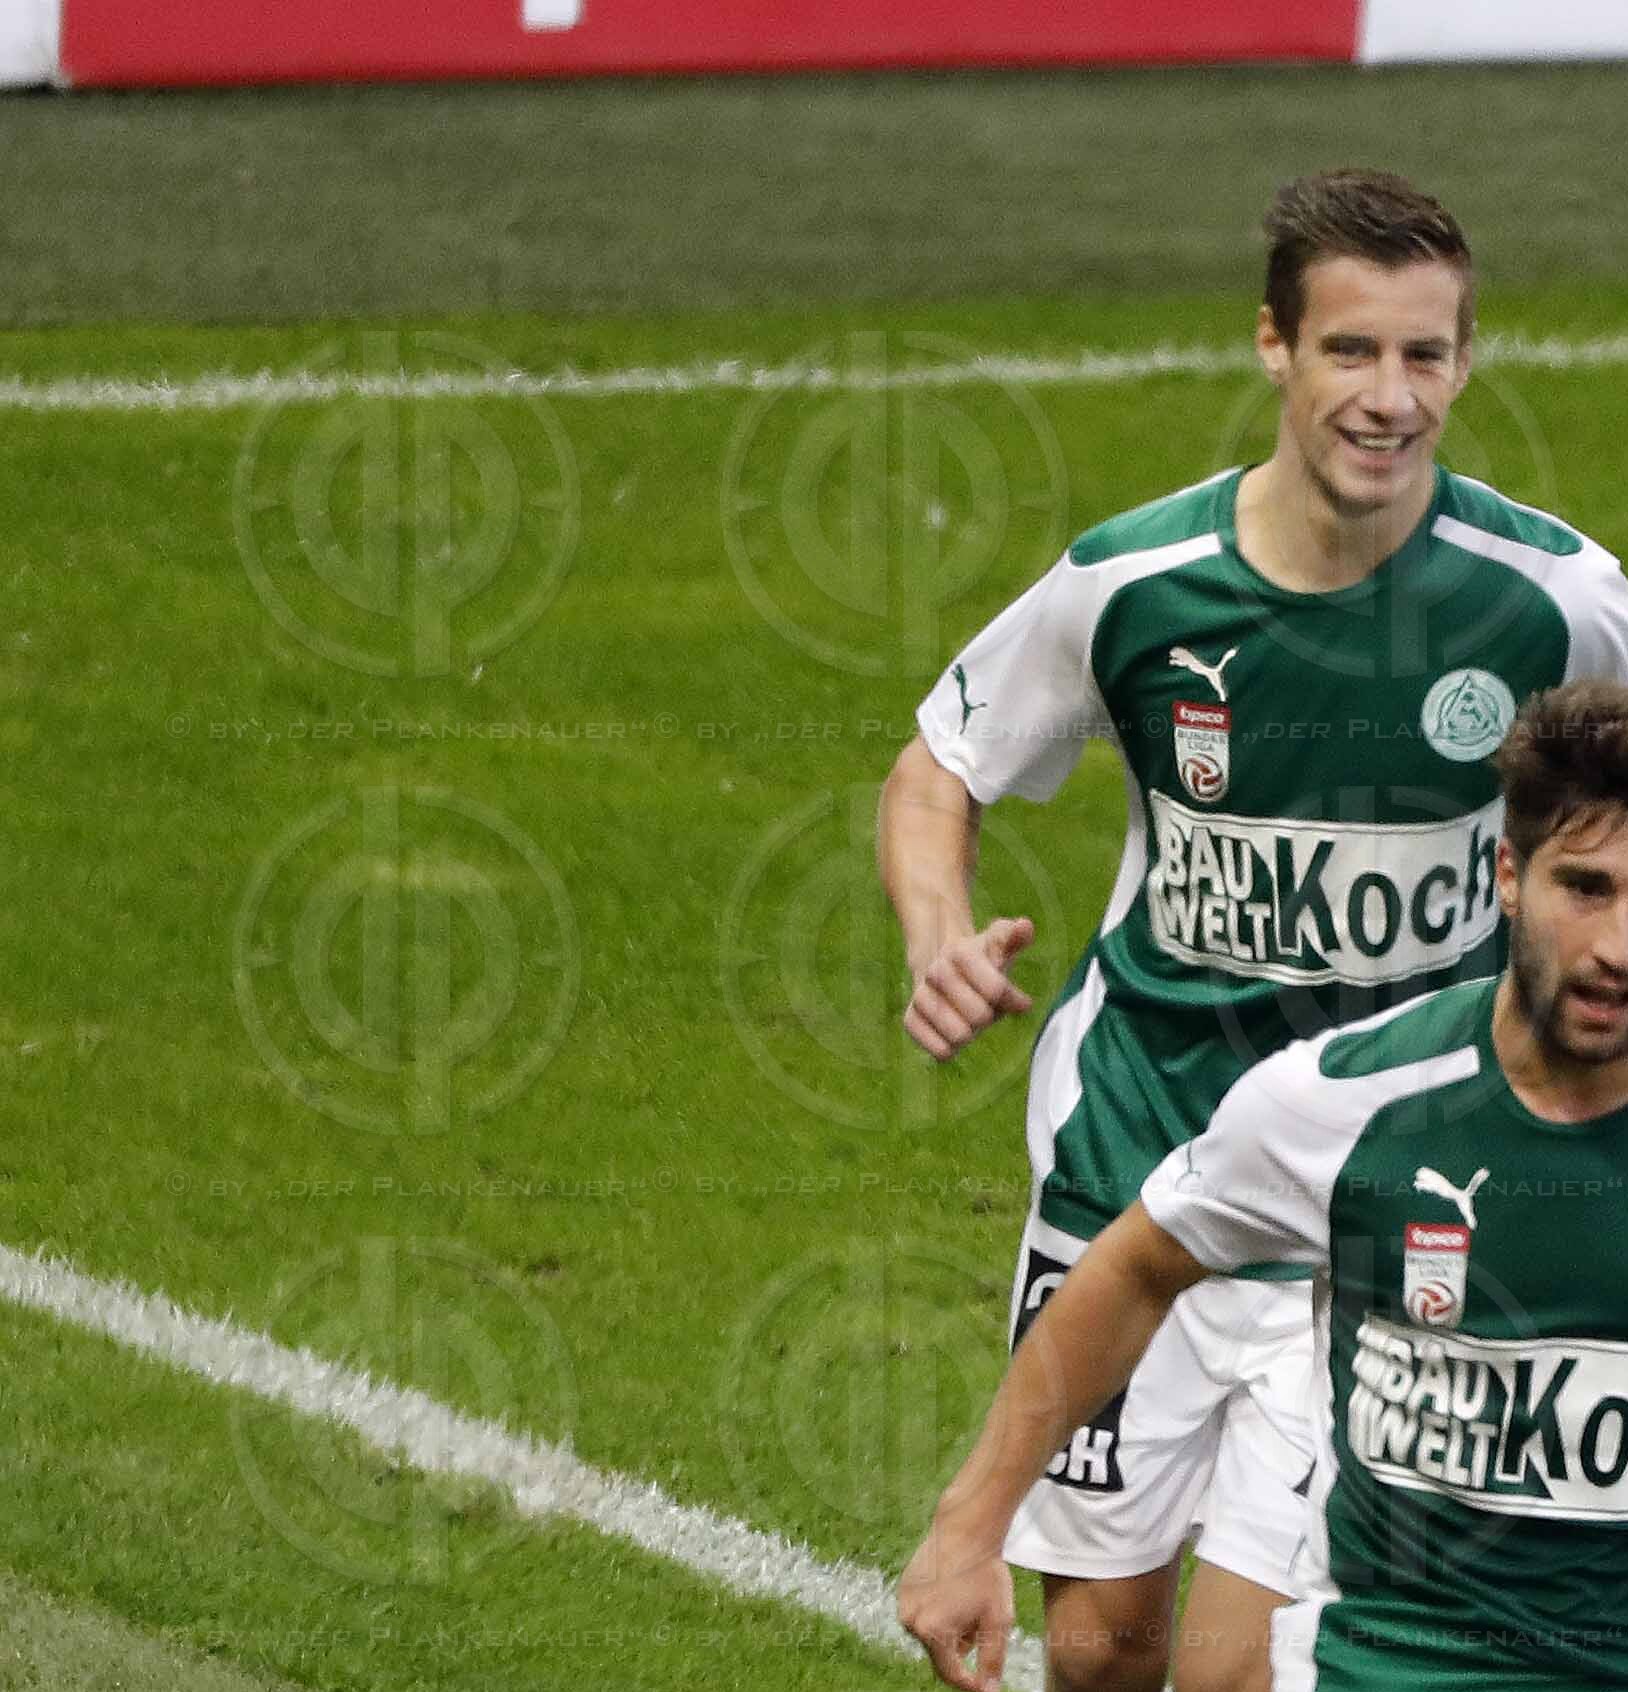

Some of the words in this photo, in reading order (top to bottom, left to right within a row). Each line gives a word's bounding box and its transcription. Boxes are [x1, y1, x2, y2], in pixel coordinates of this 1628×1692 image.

[1153, 890, 1272, 962] WELT
[1274, 822, 1498, 958] Koch
[1160, 820, 1251, 901] BAU
